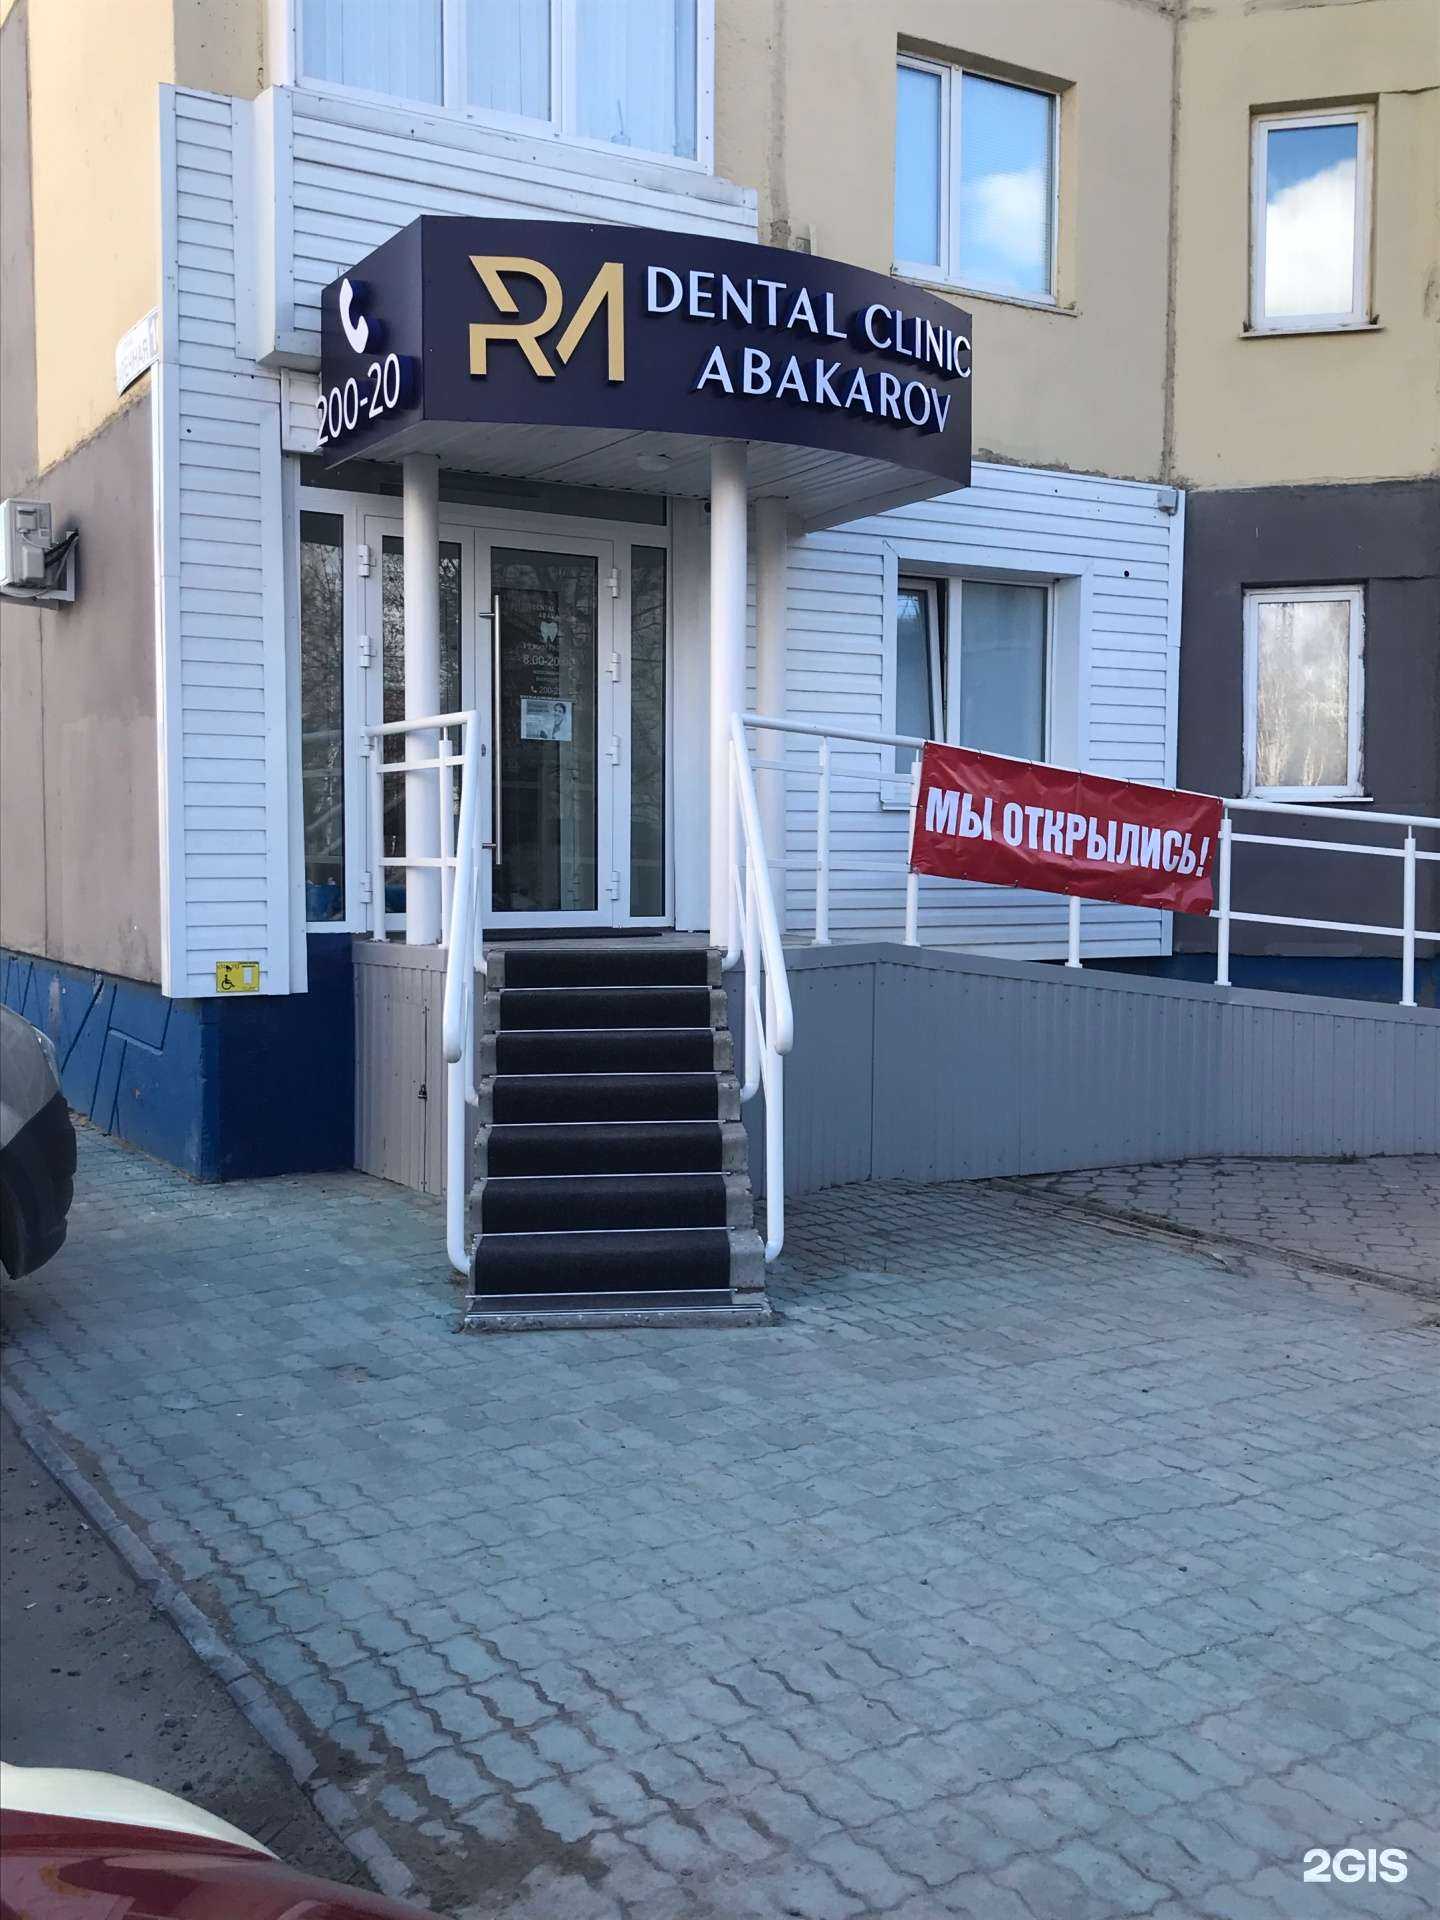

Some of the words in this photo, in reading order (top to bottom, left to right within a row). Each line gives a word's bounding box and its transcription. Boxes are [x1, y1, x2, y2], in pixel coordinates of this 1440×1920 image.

[646, 265, 848, 339] DENTAL
[863, 303, 972, 379] CLINIC
[315, 353, 401, 449] 200-20
[695, 345, 952, 434] ABAKAROV
[924, 786, 994, 841] МЫ
[1001, 802, 1211, 878] ОТКРЫЛИСЬ!
